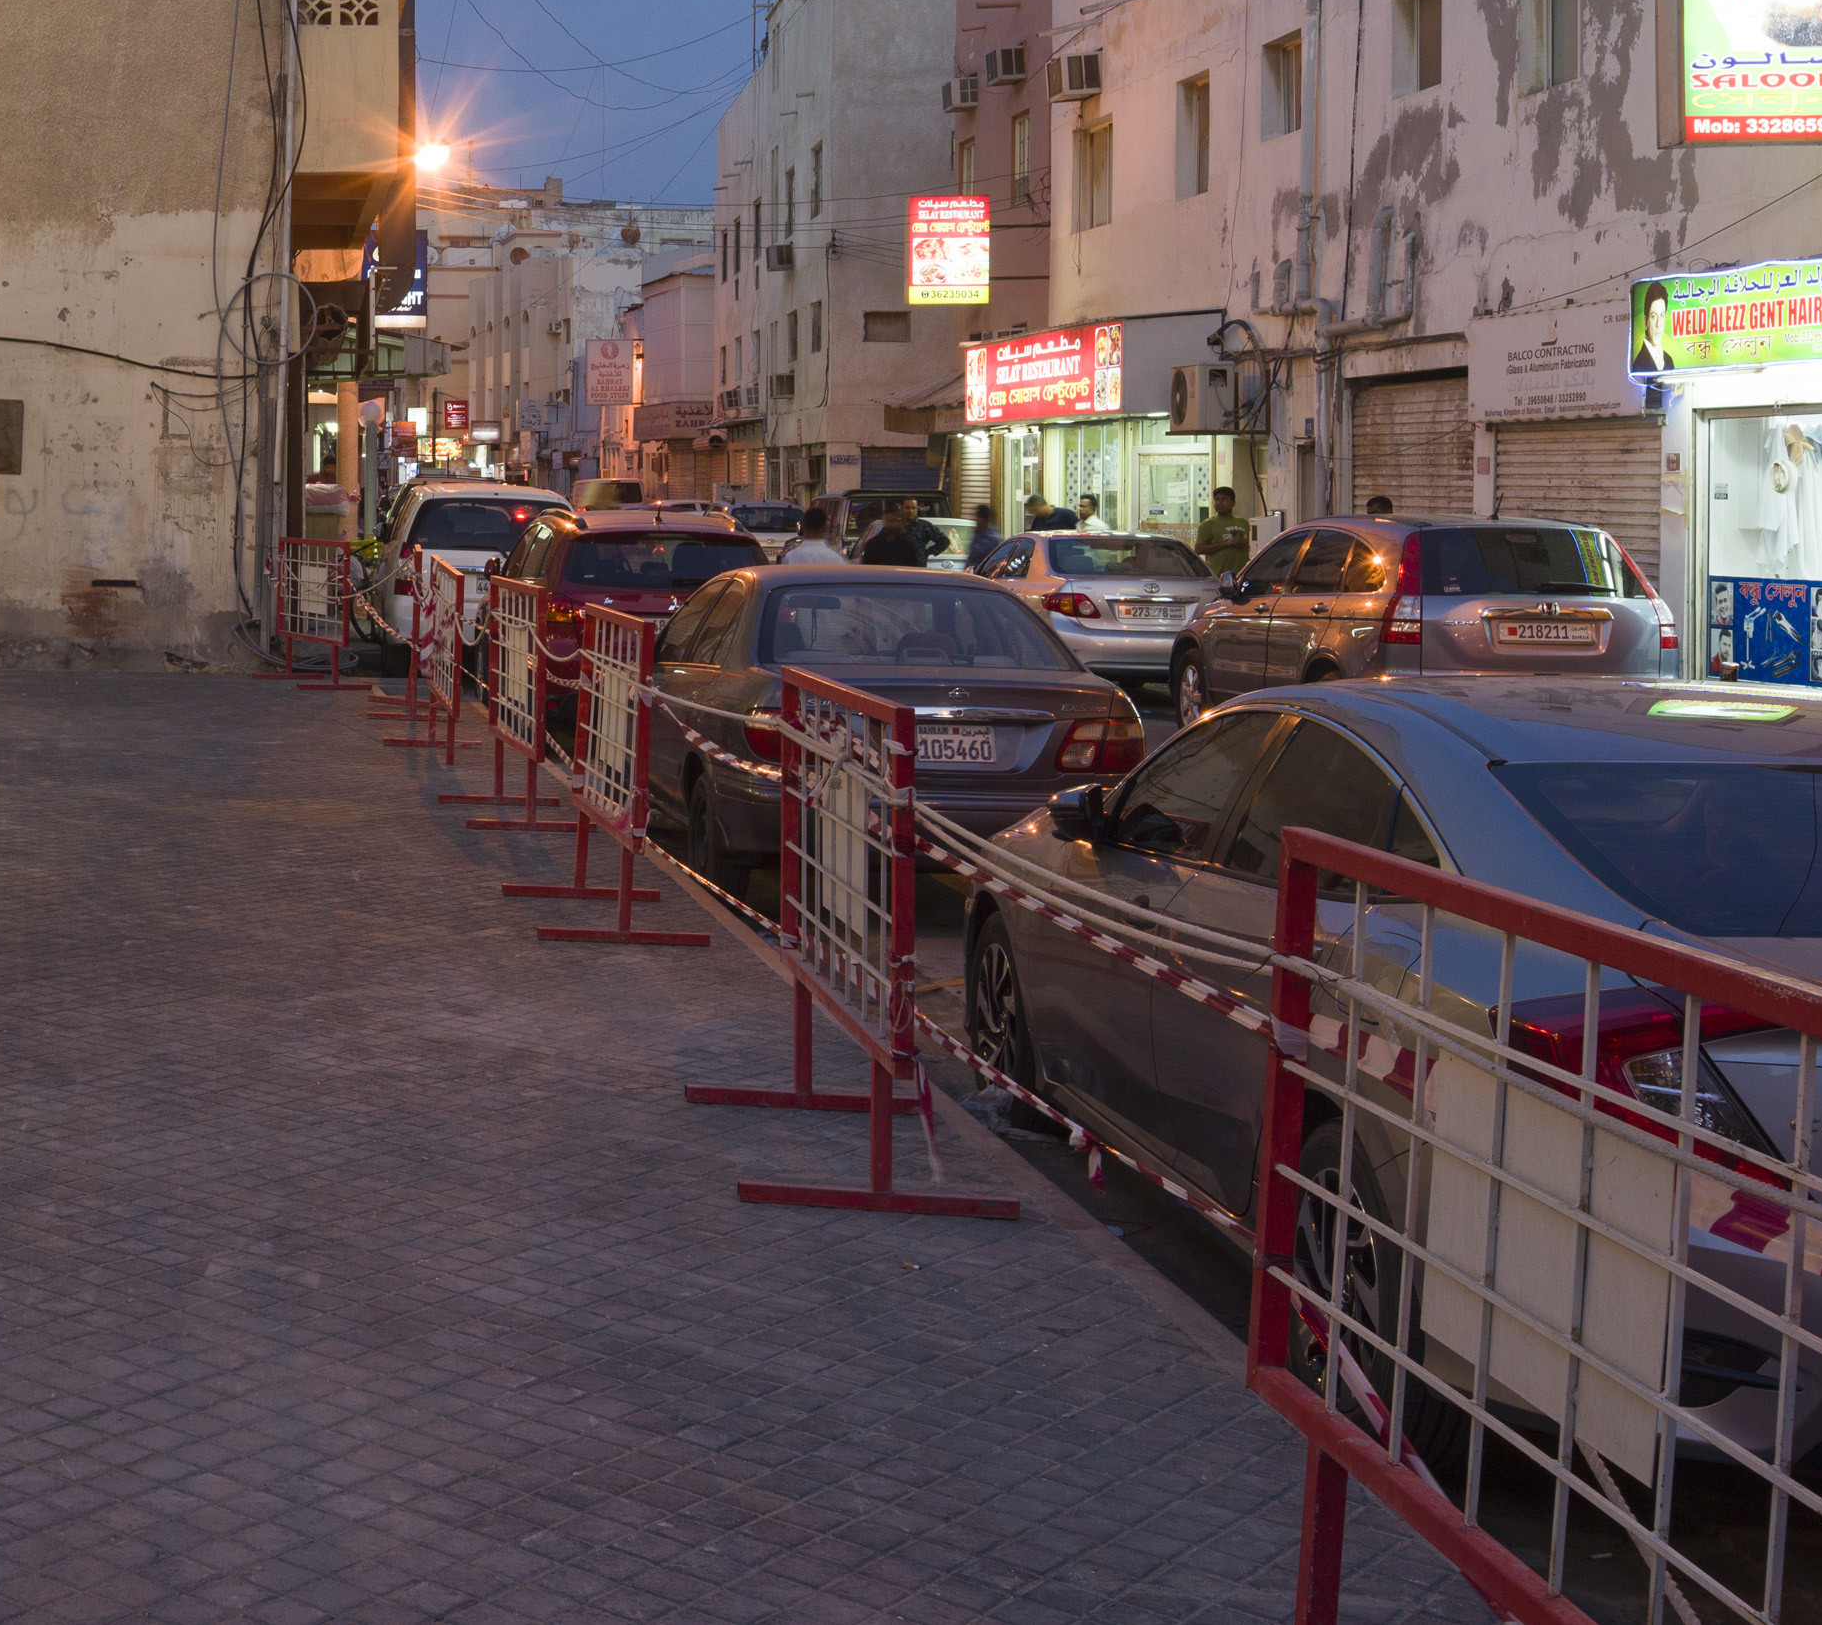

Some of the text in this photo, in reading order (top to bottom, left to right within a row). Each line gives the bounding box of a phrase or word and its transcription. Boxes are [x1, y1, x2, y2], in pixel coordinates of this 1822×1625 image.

[1694, 119, 1740, 133] Mob:
[950, 199, 985, 208] مطعم
[940, 210, 985, 219] RESTAURANT
[1724, 274, 1773, 294] للحلاقة
[1776, 269, 1802, 294] العز
[930, 290, 979, 298] 36235034
[1673, 278, 1720, 305] الرجالية
[1672, 308, 1706, 337] WELD
[1710, 303, 1746, 334] ALEZZ
[1750, 300, 1785, 330] GENT
[1788, 294, 1822, 325] HAIR
[997, 335, 1081, 363] مطعم سيلات
[1508, 343, 1595, 362] BALCO CONTRACTING
[1685, 334, 1772, 359] বন্ধু সেলুন
[996, 355, 1081, 384] SELAT RESTAURANT
[1506, 364, 1524, 375] (Glass
[1530, 361, 1559, 372] Aluminium
[1560, 358, 1596, 370] Fabricators)
[1558, 392, 1586, 403] 33252990
[1739, 581, 1808, 607] বন্ধু সেলুন
[1518, 625, 1569, 639] 218211
[918, 726, 948, 735] BAHRAIN
[961, 726, 991, 736] البحرين
[919, 739, 992, 761] 105460
